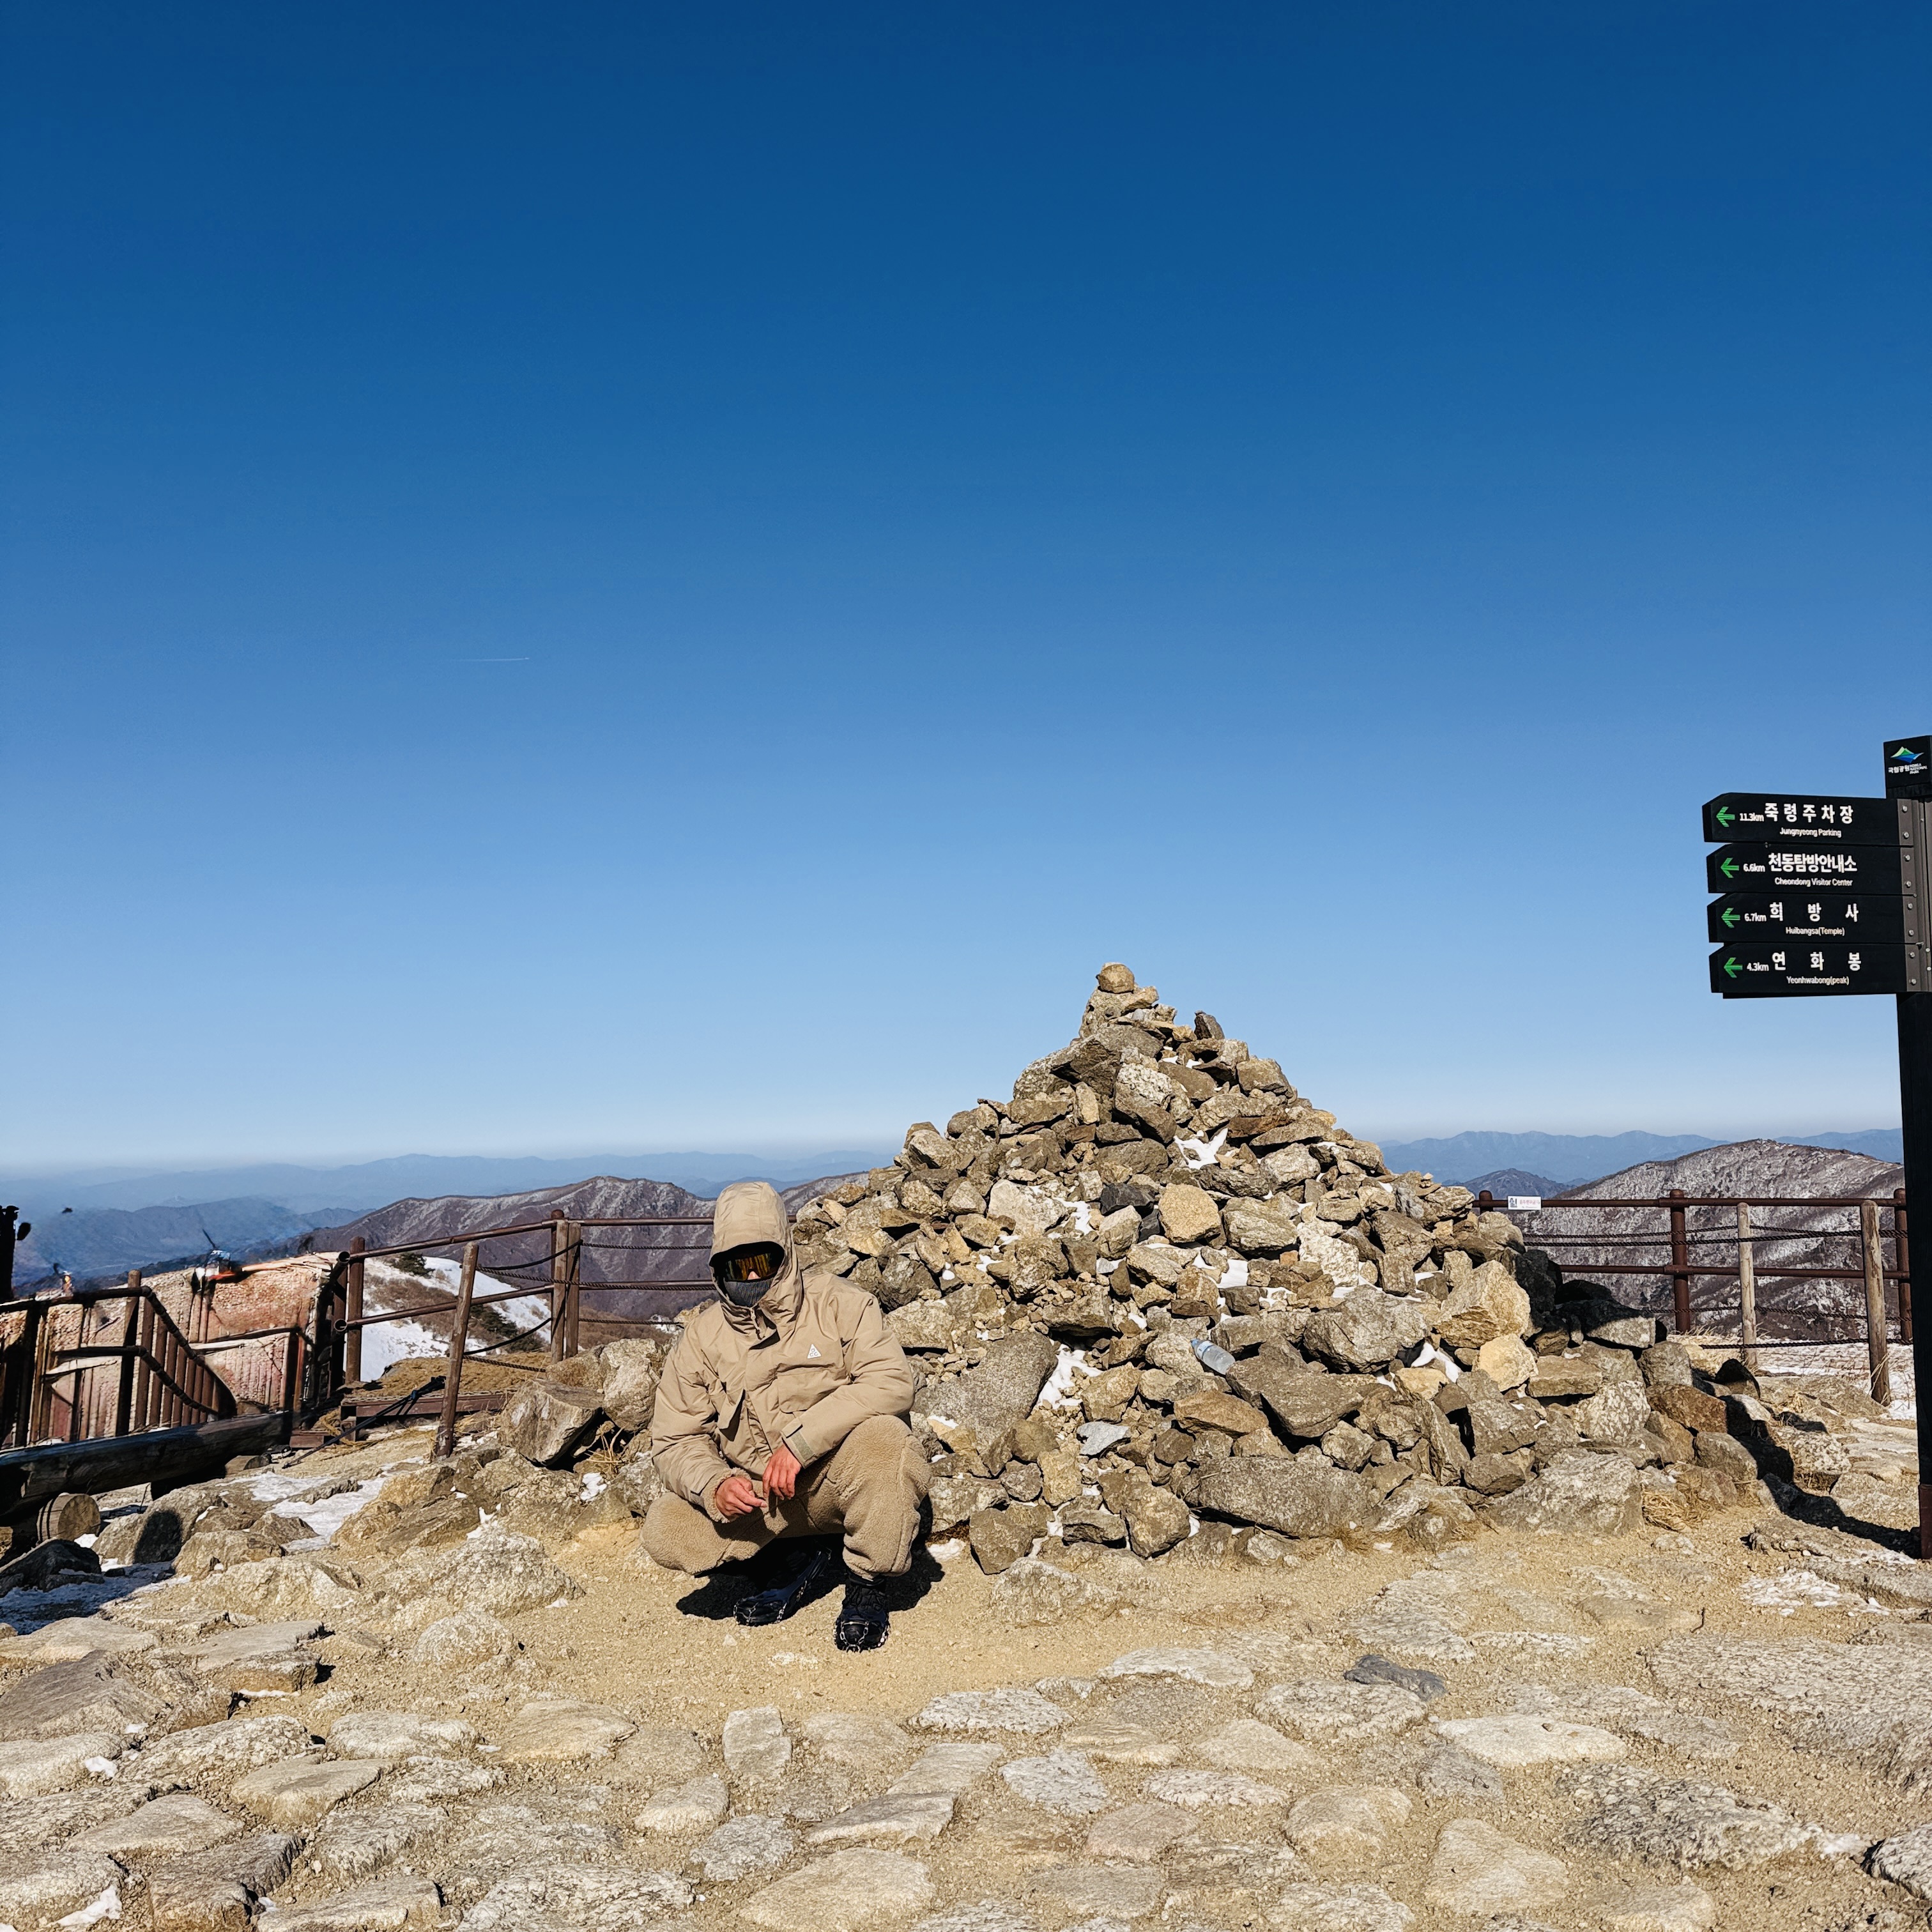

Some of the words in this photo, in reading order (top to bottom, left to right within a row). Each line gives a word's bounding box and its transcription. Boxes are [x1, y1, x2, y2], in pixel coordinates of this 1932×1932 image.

[1740, 813, 1764, 822] 11.3km
[1780, 827, 1818, 837] Jungnyeong
[1818, 829, 1841, 838] Parking
[1744, 863, 1765, 872] 6.6km
[1768, 853, 1857, 873] 천동탐방안내소
[1775, 877, 1811, 887] Cheondong
[1745, 913, 1767, 921] 6.7km
[1786, 927, 1844, 936] Huibangsa(Temple)
[1747, 962, 1769, 971] 4.3km
[1786, 976, 1849, 985] Yeonhwabong(peak)
